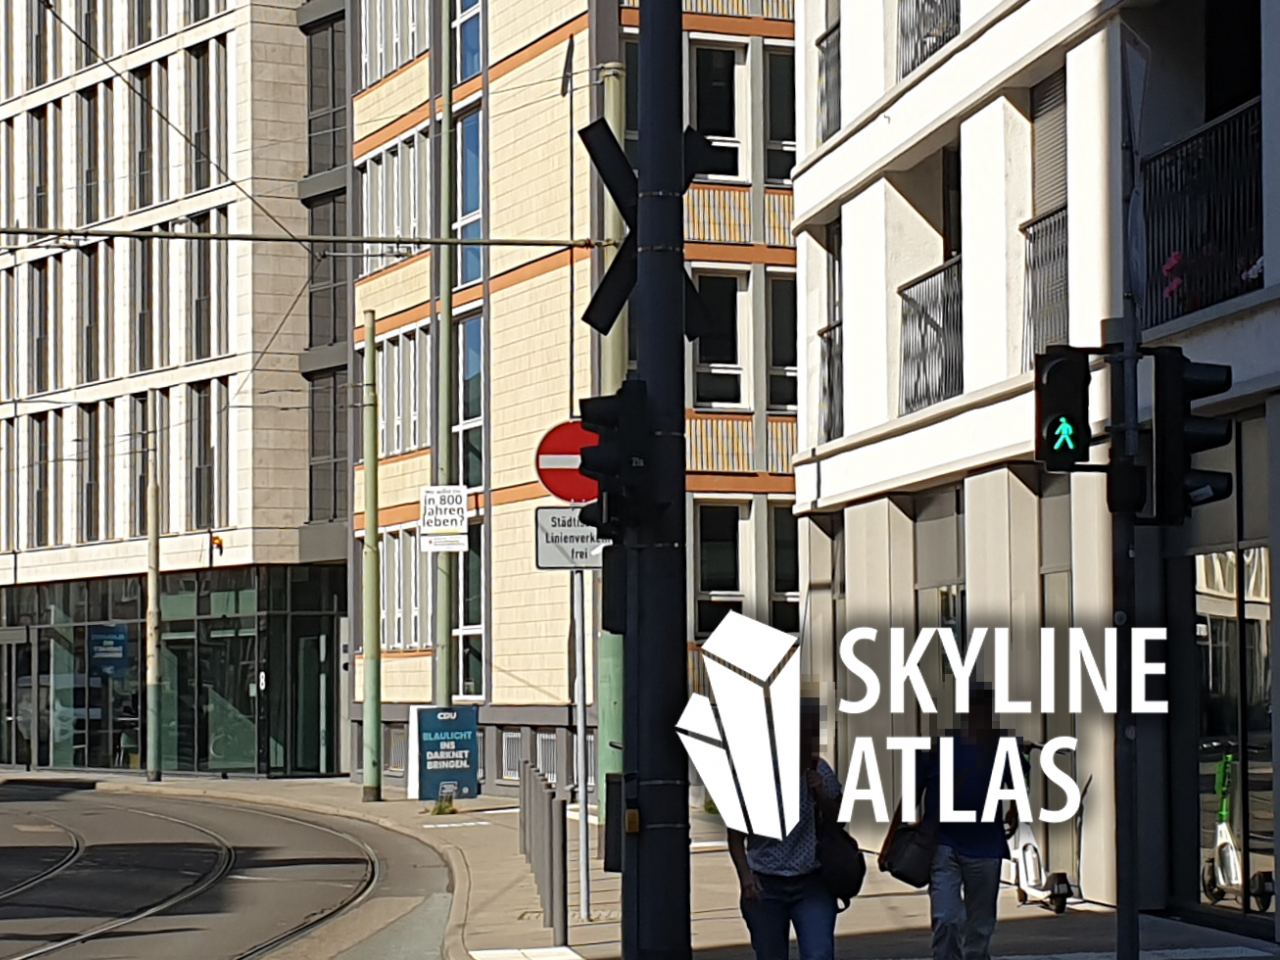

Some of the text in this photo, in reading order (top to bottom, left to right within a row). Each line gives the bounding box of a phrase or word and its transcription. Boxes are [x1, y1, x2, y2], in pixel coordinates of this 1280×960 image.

[439, 494, 463, 505] 800
[423, 505, 464, 516] Jahren
[422, 515, 465, 527] leben?
[571, 547, 588, 559] frei
[259, 671, 266, 691] 8
[437, 712, 457, 720] CDU
[422, 731, 473, 741] BLAULICHT
[440, 741, 456, 750] INS
[426, 750, 470, 760] DARKNET
